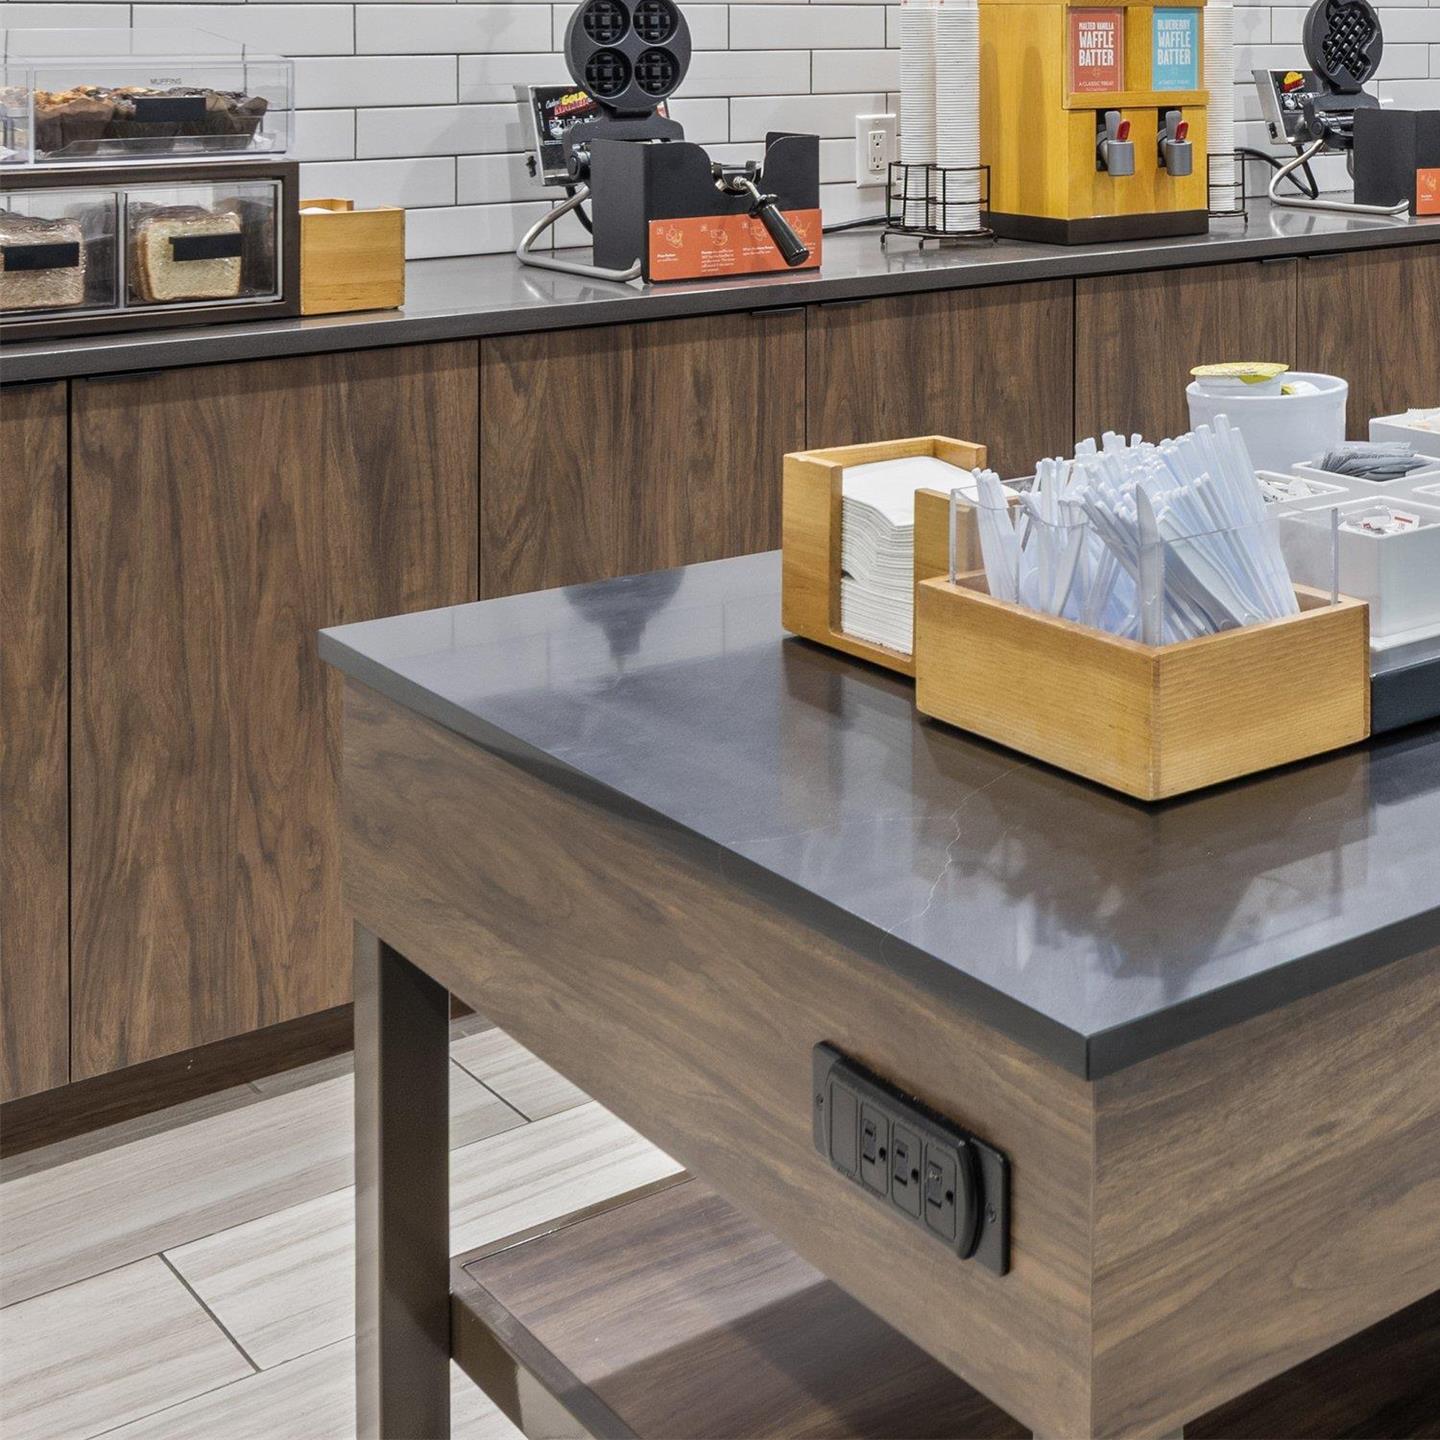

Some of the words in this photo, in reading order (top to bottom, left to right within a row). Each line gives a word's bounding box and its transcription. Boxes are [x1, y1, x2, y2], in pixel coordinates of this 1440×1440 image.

[1079, 31, 1114, 48] WAFFLE
[1158, 31, 1191, 48] WAFFLE
[1079, 49, 1114, 66] BATTER
[1157, 49, 1191, 65] BATTER
